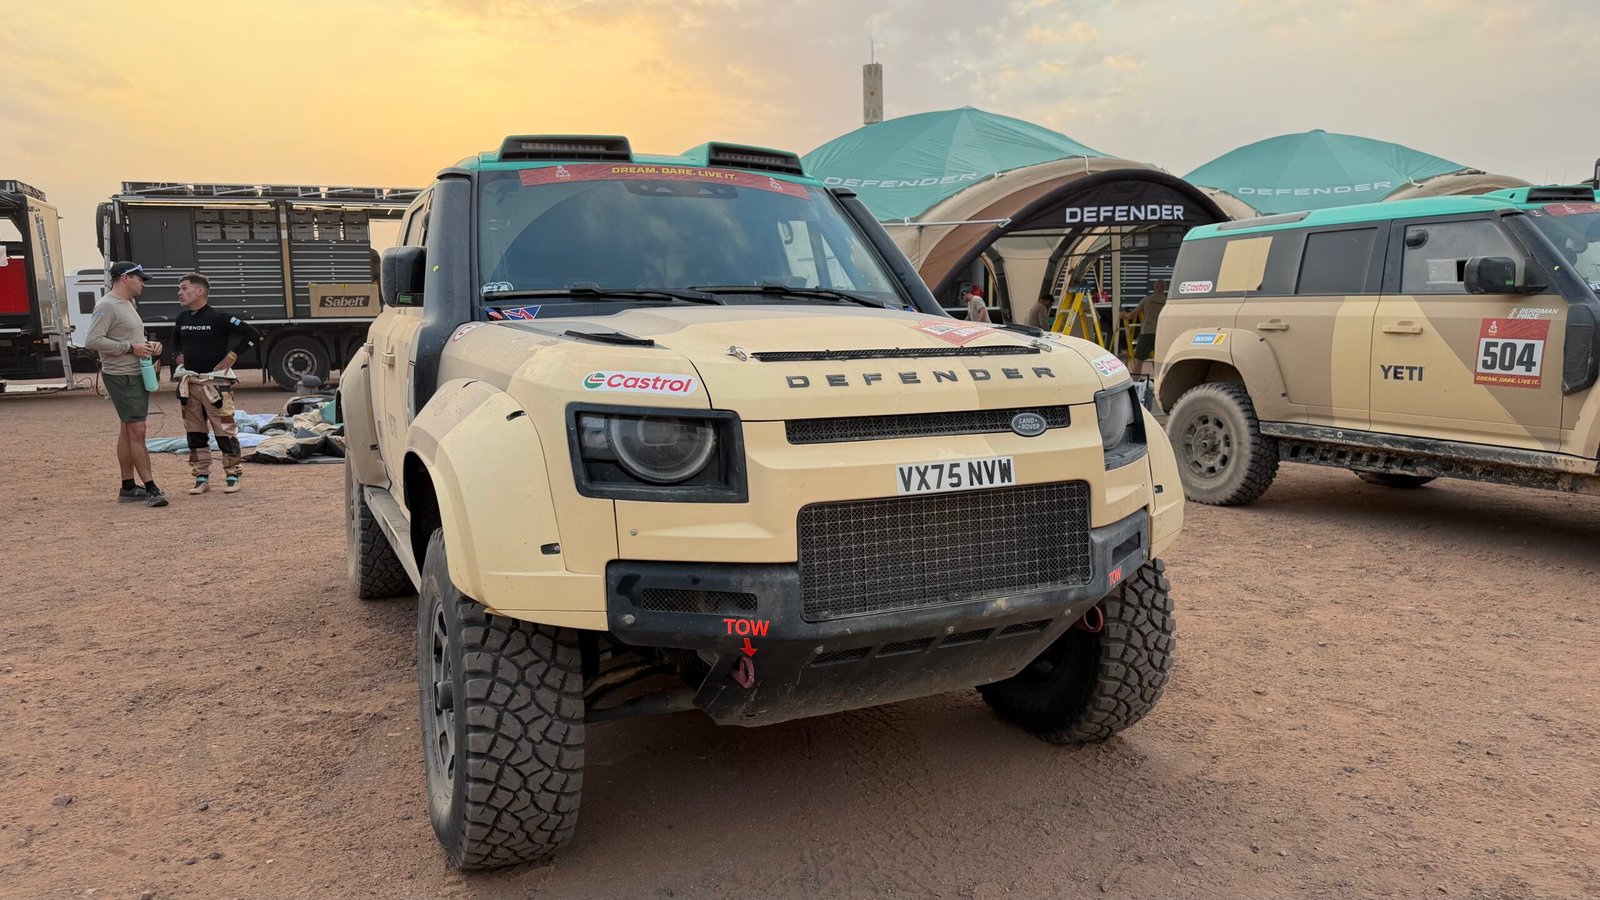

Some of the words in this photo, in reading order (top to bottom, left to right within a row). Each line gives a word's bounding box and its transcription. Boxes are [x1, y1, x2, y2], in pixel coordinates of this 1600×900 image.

[612, 166, 659, 174] DREAM.
[661, 168, 696, 176] DARE.
[698, 170, 720, 179] LIVE
[720, 172, 738, 180] IT.
[824, 172, 977, 188] DEFENDER
[1238, 181, 1392, 196] DEFENDER
[1065, 204, 1184, 223] DEFENDER
[1186, 283, 1211, 292] Castrol
[324, 296, 365, 307] Sabelt
[1481, 341, 1537, 373] 504
[786, 366, 1056, 388] DEFENDER
[1380, 364, 1424, 382] YETI
[606, 374, 693, 393] Castrol
[899, 463, 962, 492] VX75
[967, 458, 1012, 487] NVW
[1109, 565, 1122, 587] TOW
[723, 618, 770, 636] TOW
